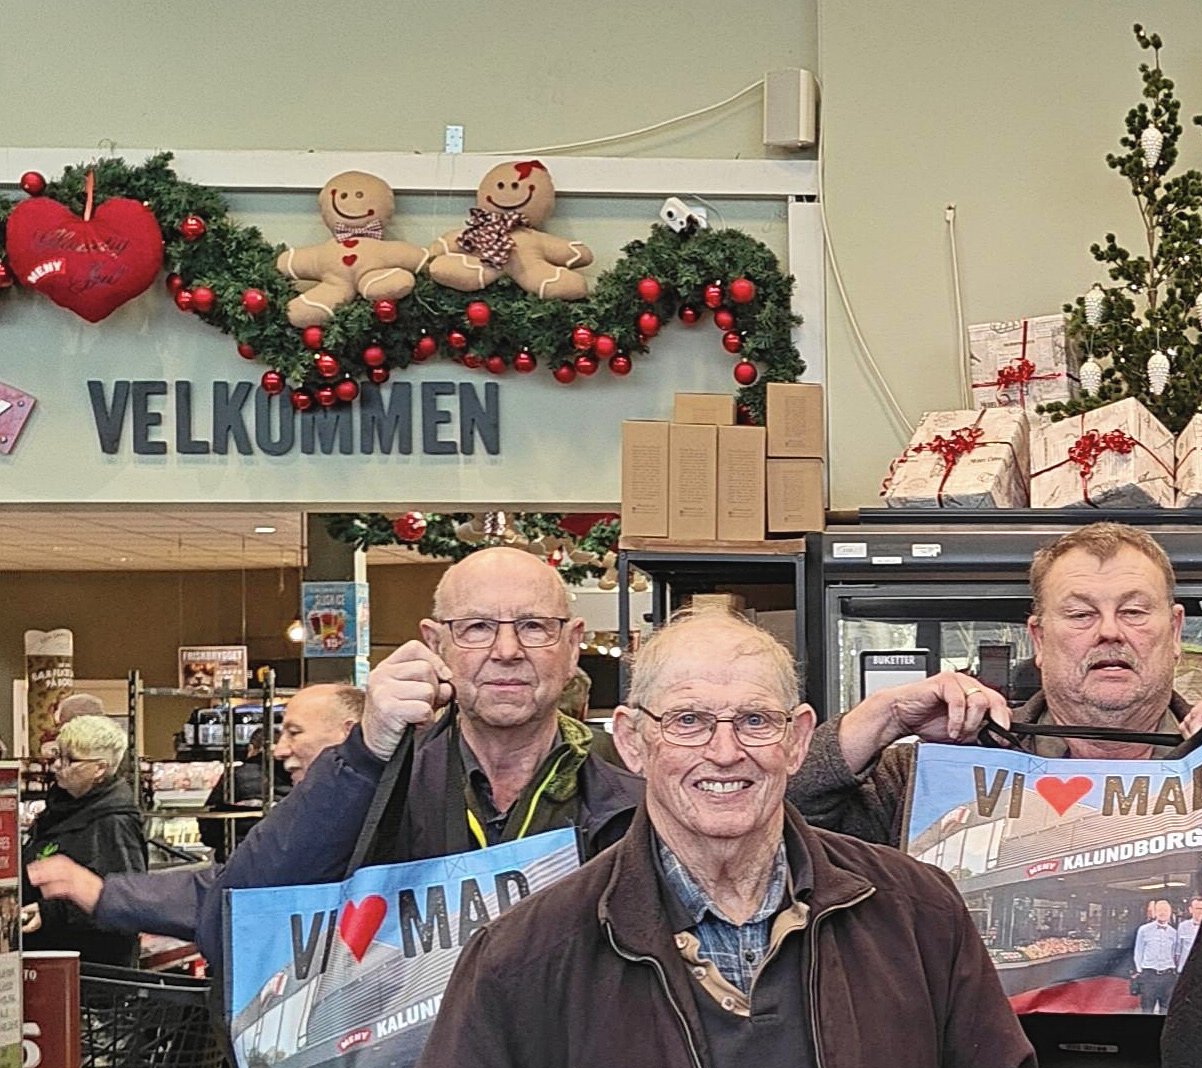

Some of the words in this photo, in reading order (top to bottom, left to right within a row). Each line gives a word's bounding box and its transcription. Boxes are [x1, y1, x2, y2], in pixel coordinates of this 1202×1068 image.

[27, 259, 63, 284] MENY
[87, 380, 500, 456] VELKOMMEN
[872, 655, 915, 665] BUKETTER
[973, 765, 1025, 819] VI
[1027, 861, 1058, 877] MENY
[289, 907, 338, 980] VI
[397, 869, 531, 959] MAD
